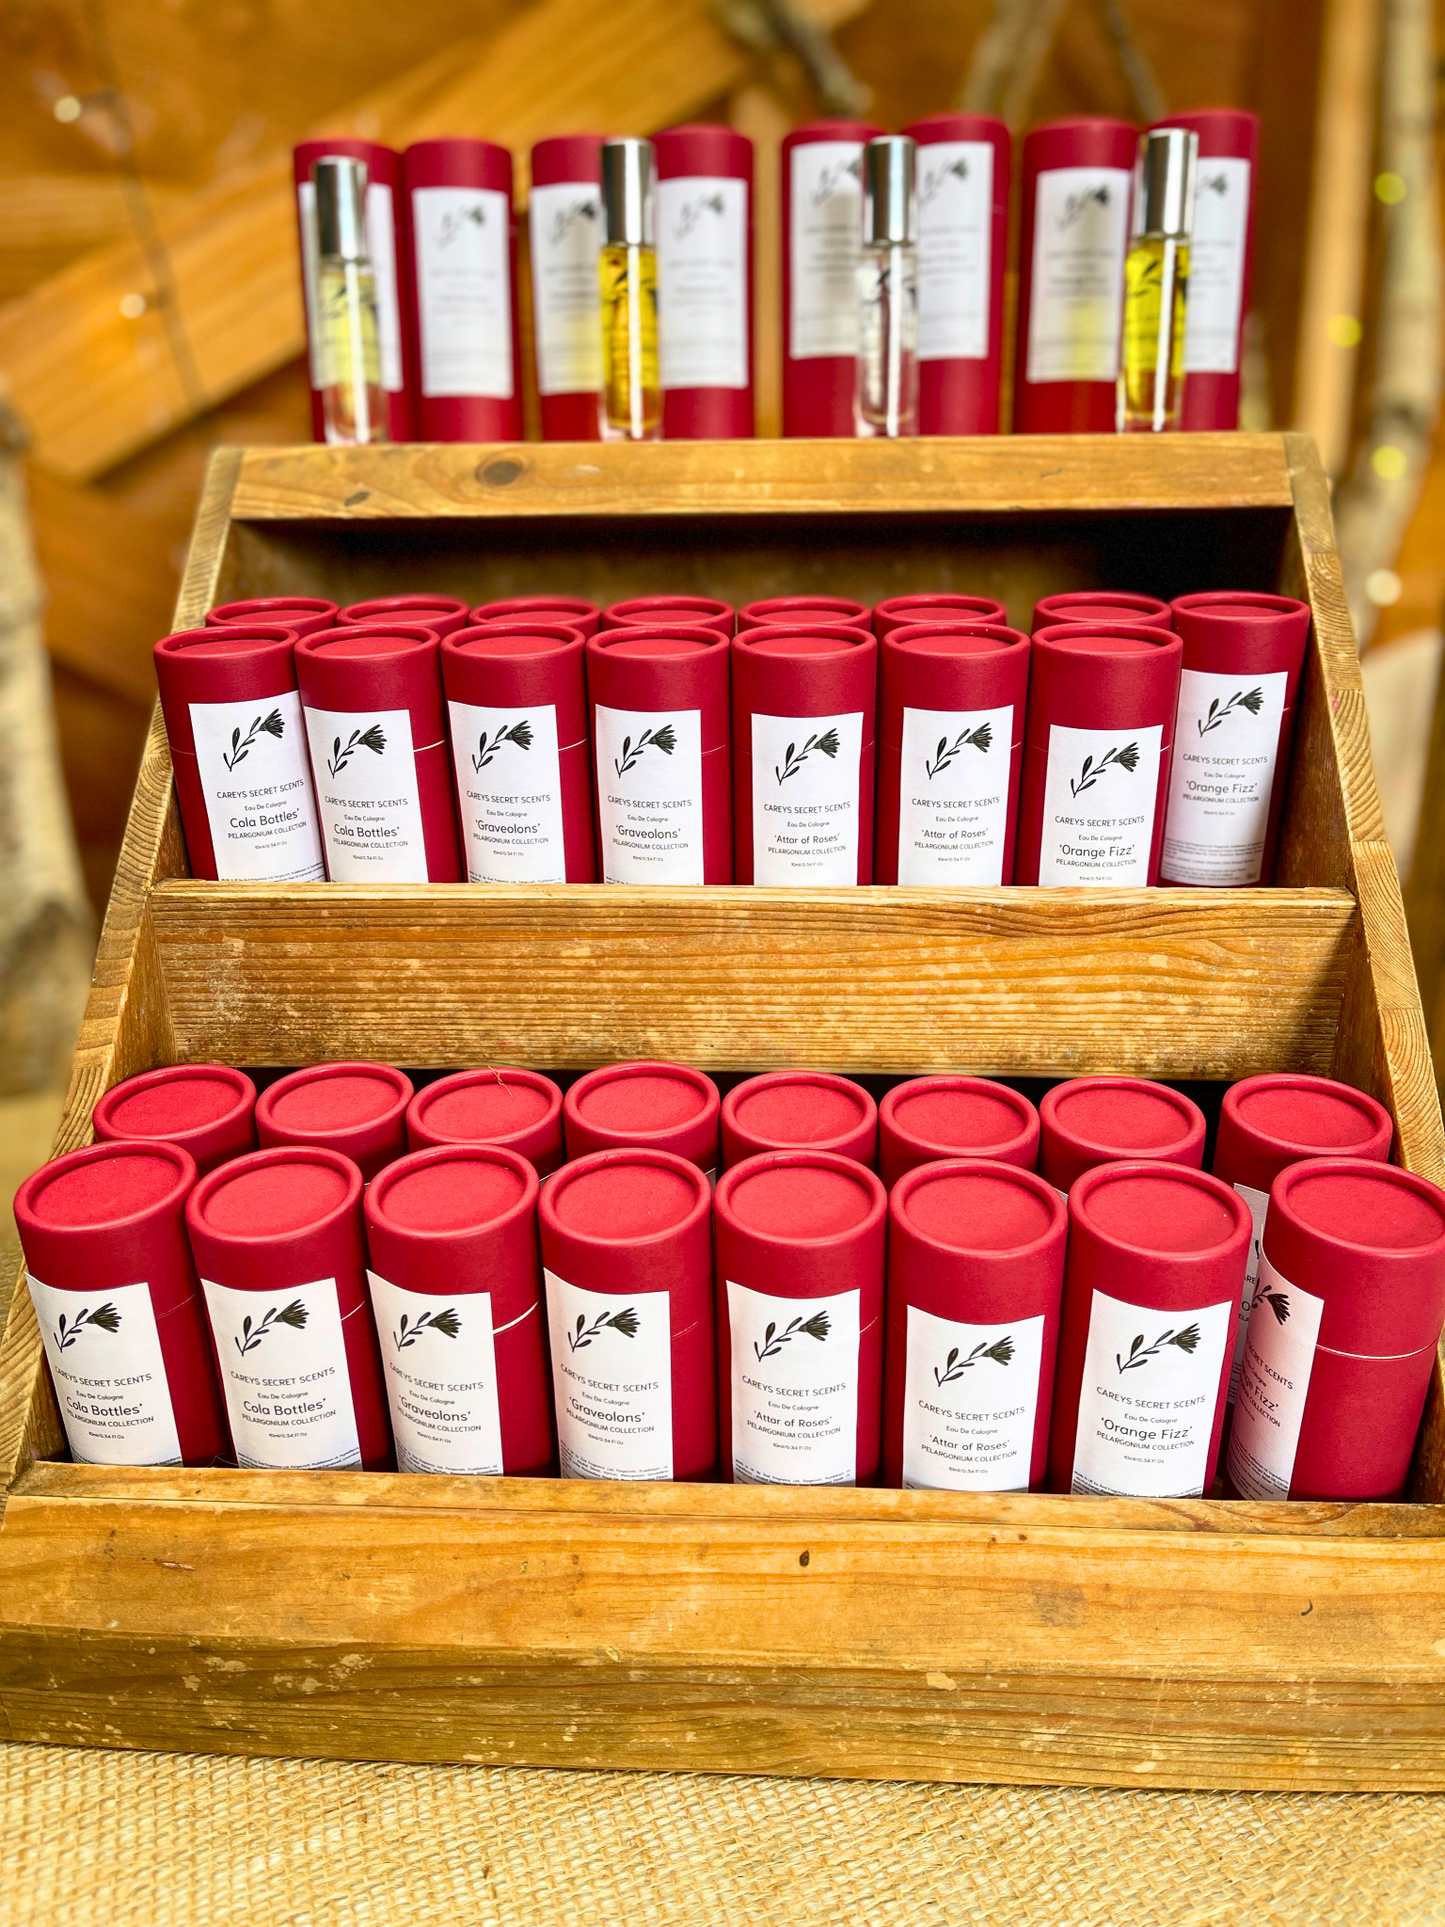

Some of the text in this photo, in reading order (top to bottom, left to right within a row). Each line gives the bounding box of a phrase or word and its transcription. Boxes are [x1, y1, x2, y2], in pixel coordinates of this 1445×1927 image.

[1183, 754, 1210, 764] CAREYS
[1242, 756, 1268, 765] SCENTS
[216, 779, 305, 799] CAREYS SECRET SCENTS
[324, 796, 408, 809] CAREYS SECRET SCENTS
[466, 791, 551, 804] CAREYS SECRET SCENTS
[608, 796, 692, 809] CAREYS SECRET SCENTS
[912, 796, 1000, 809] CAREYS SECRET SCENTS
[1182, 794, 1224, 803] PELARGONIUM
[266, 800, 287, 808] Cologne
[764, 802, 851, 814] CAREYS SECRET SCENTS
[1054, 816, 1145, 827] CAREYS SECRET SCENTS
[228, 821, 307, 839] PELARGONIUM COLLECTION
[949, 831, 958, 839] of
[333, 838, 370, 848] PELARGONIUM
[473, 833, 510, 844] PELARGONIUM
[612, 838, 689, 851] PELARGONIUM COLLECTION
[801, 836, 810, 844] of
[768, 845, 847, 855] PELARGONIUM COLLECTION
[914, 840, 994, 850] PELARGONIUM COLLECTION
[1056, 859, 1137, 868] PELARGONIUM COLLECTION
[80, 1378, 111, 1387] SECRET
[114, 1373, 152, 1387] SCENTS
[230, 1367, 336, 1387] CAREYS SECRET SCENTS
[414, 1378, 444, 1391] SECRET
[447, 1382, 484, 1392] SCENTS
[588, 1379, 620, 1392] SECRET
[622, 1382, 659, 1393] SCENTS
[742, 1375, 846, 1397] CAREYS SECRET SCENTS
[76, 1390, 86, 1398] Eau
[410, 1390, 420, 1399] Eau
[430, 1397, 456, 1405] Cologne
[582, 1391, 593, 1400] Eau
[604, 1398, 630, 1407] Cologne
[1096, 1387, 1206, 1409] CAREYS SECRET SCENTS
[768, 1401, 781, 1409] Eau
[918, 1400, 1026, 1421] CAREYS SECRET SCENTS
[108, 1416, 154, 1427] COLLECTION
[242, 1410, 336, 1426] PELARGONIUM COLLECTION
[1124, 1413, 1138, 1421] Eau
[437, 1425, 481, 1433] COLLECTION
[747, 1420, 841, 1439] PELARGONIUM COLLECTION
[784, 1419, 796, 1428] of
[610, 1426, 655, 1434] COLLECTION
[962, 1443, 974, 1451] of
[1096, 1431, 1195, 1451] PELARGONIUM COLLECTION
[922, 1444, 1018, 1463] PELARGONIUM COLLECTION
